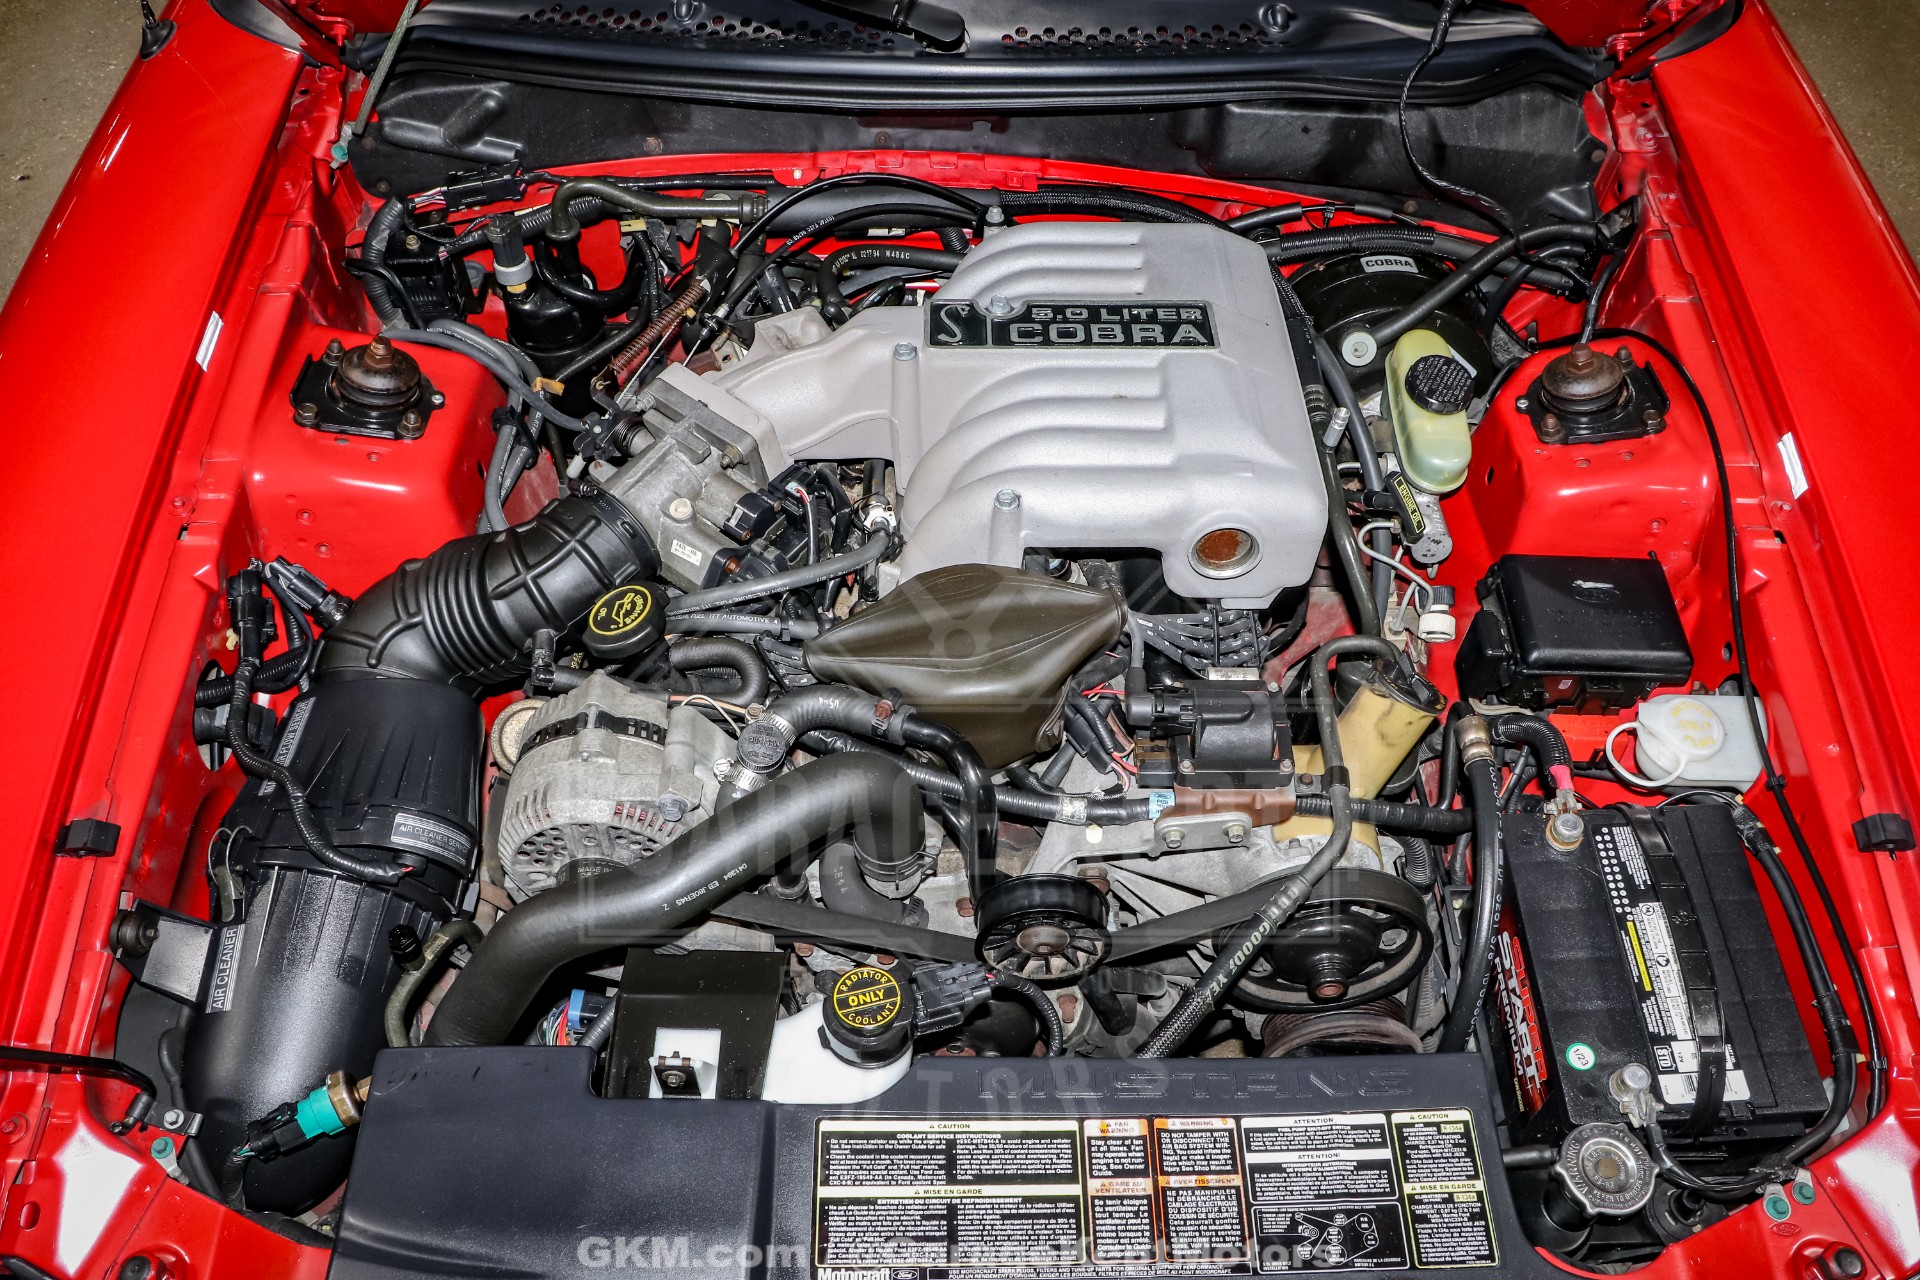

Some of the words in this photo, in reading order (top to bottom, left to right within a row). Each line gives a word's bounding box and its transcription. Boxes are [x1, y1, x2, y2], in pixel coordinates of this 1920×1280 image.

[1365, 258, 1413, 268] COBRA
[1031, 307, 1089, 321] 5.0
[1101, 307, 1203, 321] LITER
[1009, 323, 1208, 344] COBRA
[1400, 484, 1416, 512] ENGINE
[1412, 511, 1422, 527] OIL
[597, 607, 607, 620] OIL
[624, 594, 644, 625] ENGINE
[722, 614, 770, 624] AUTOMOTIVE
[280, 734, 294, 757] FLOW
[290, 700, 309, 730] SENSOR
[399, 824, 413, 832] AIR
[414, 827, 447, 843] CLEANER
[217, 928, 238, 985] CLEANER
[840, 971, 888, 992] RADIATOR
[213, 988, 226, 1009] AIR
[848, 989, 885, 1006] ONLY
[848, 1003, 894, 1024] COOLANT
[1494, 956, 1524, 1076] PREMIUM
[1498, 931, 1541, 1089] START
[1512, 936, 1547, 1081] SUPER
[1657, 1048, 1671, 1067] STD
[977, 1066, 1412, 1098] MUSTANG
[1567, 1140, 1589, 1194] WARNING
[817, 1268, 890, 1280] Motorcraft
